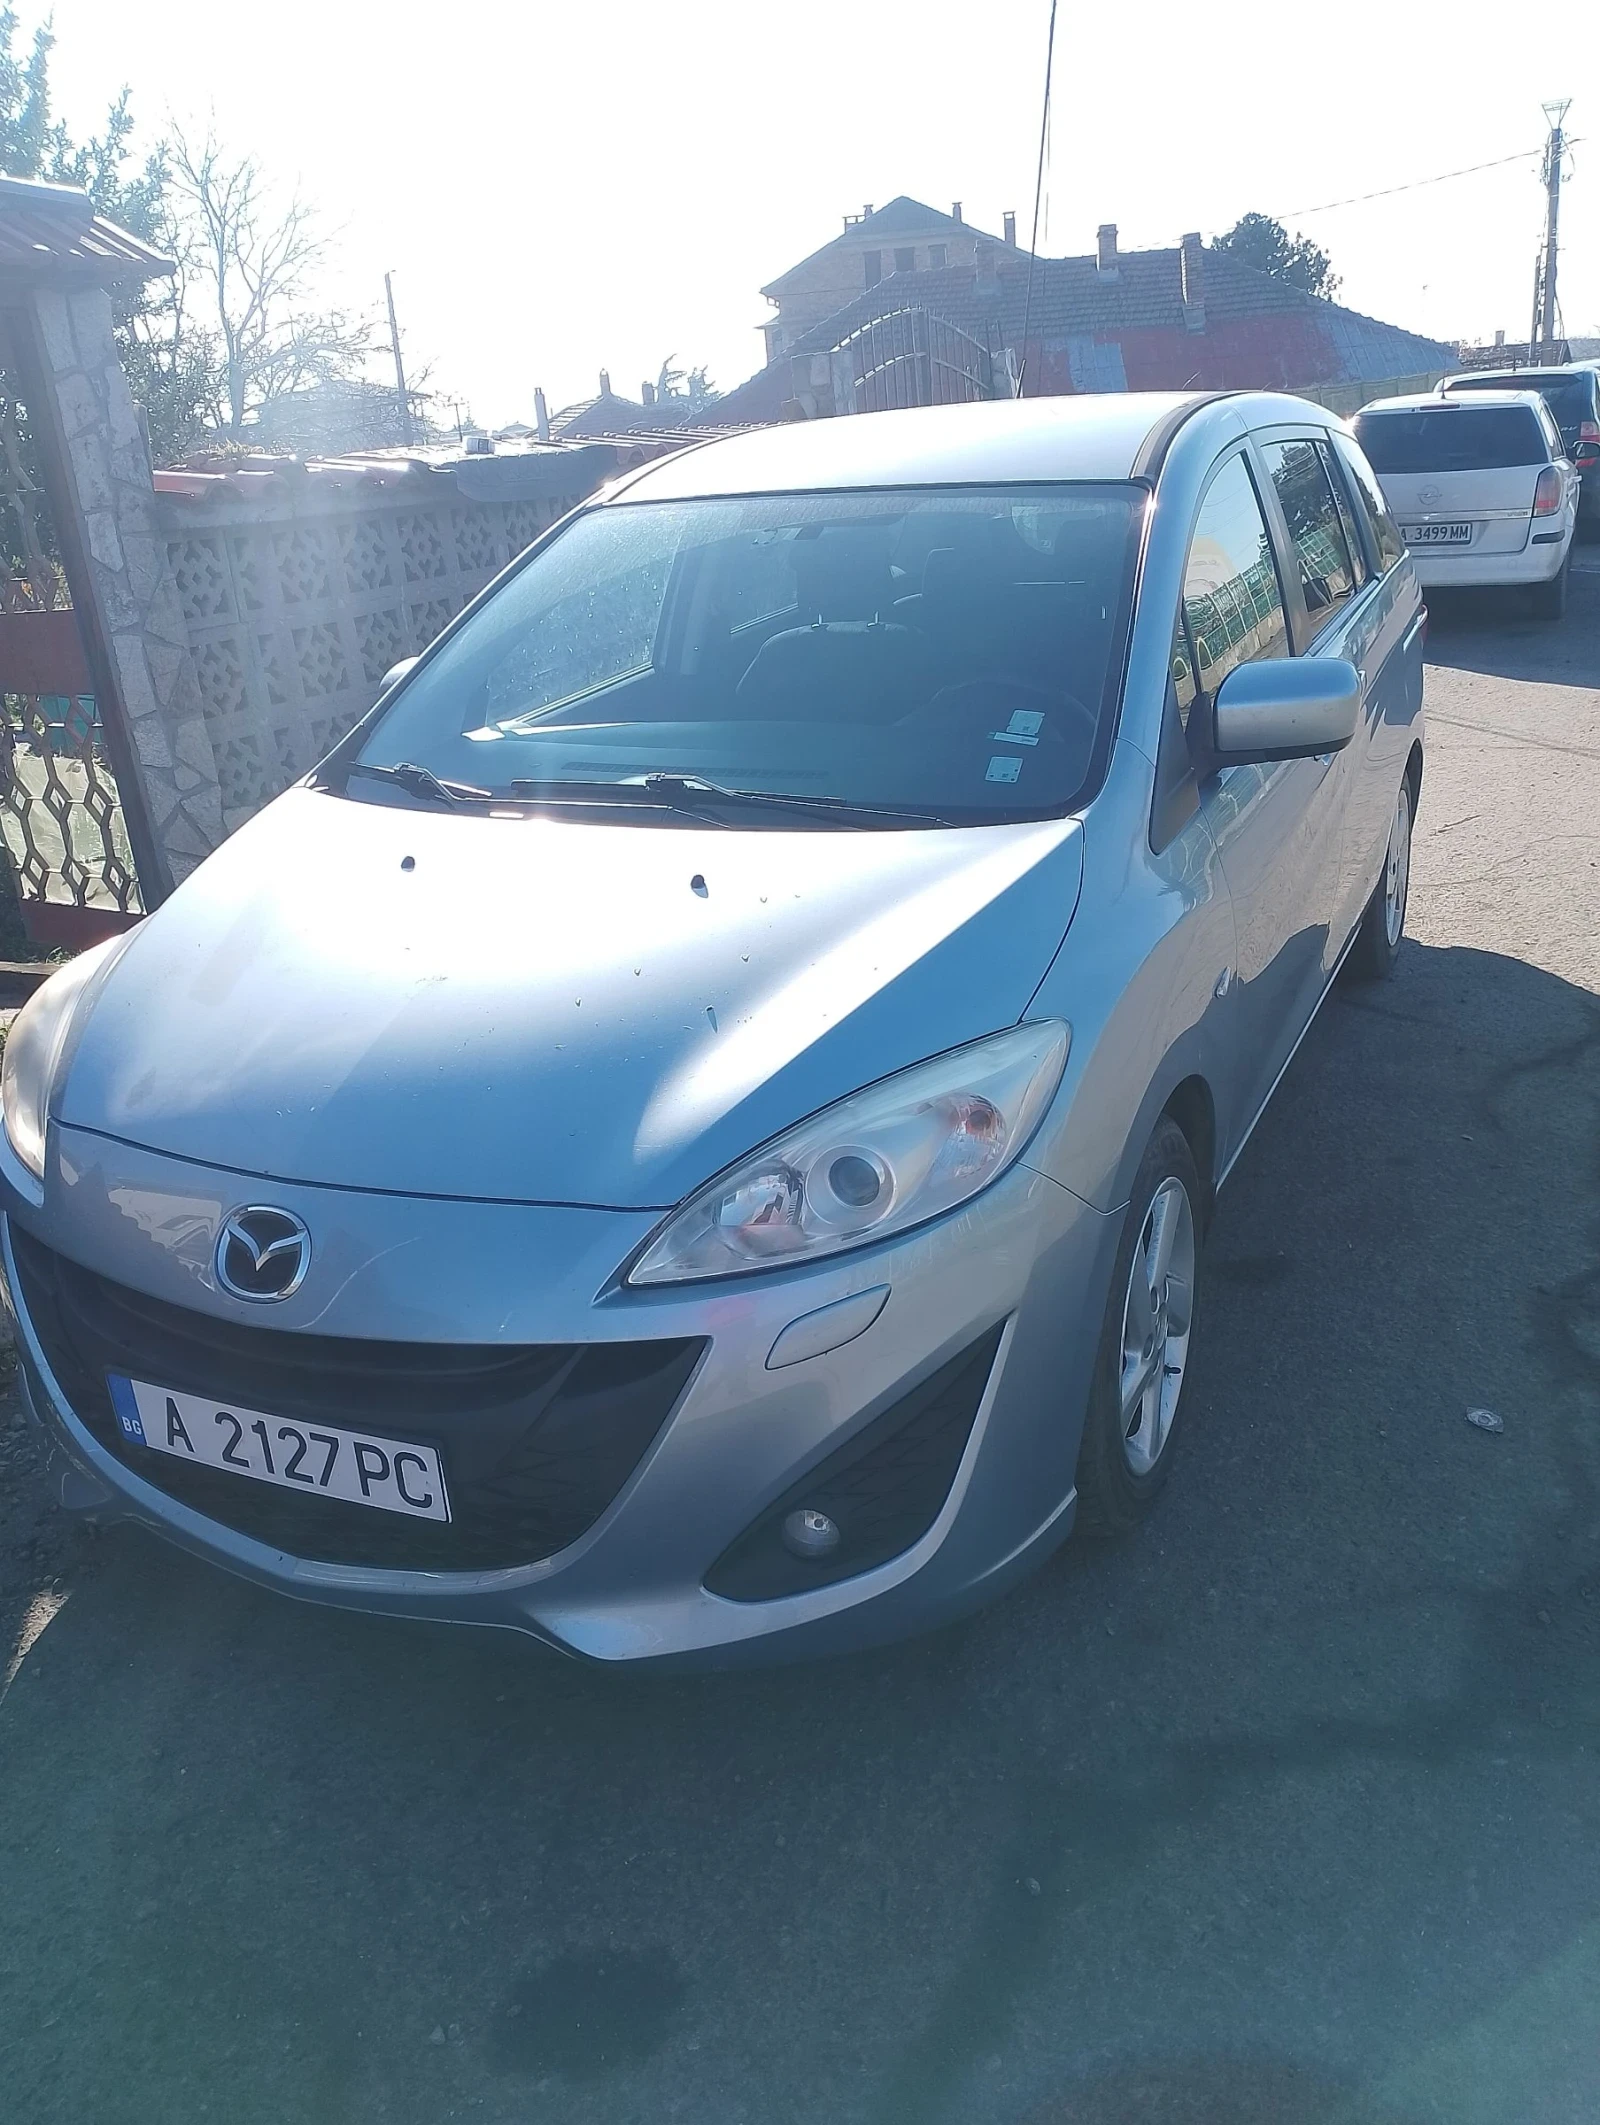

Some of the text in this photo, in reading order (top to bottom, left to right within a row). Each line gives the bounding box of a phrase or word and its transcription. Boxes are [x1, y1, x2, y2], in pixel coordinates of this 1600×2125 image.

[1414, 526, 1448, 540] 3499
[1449, 525, 1469, 539] MM
[121, 1416, 142, 1435] BG
[165, 1396, 433, 1509] A 2127 PC
